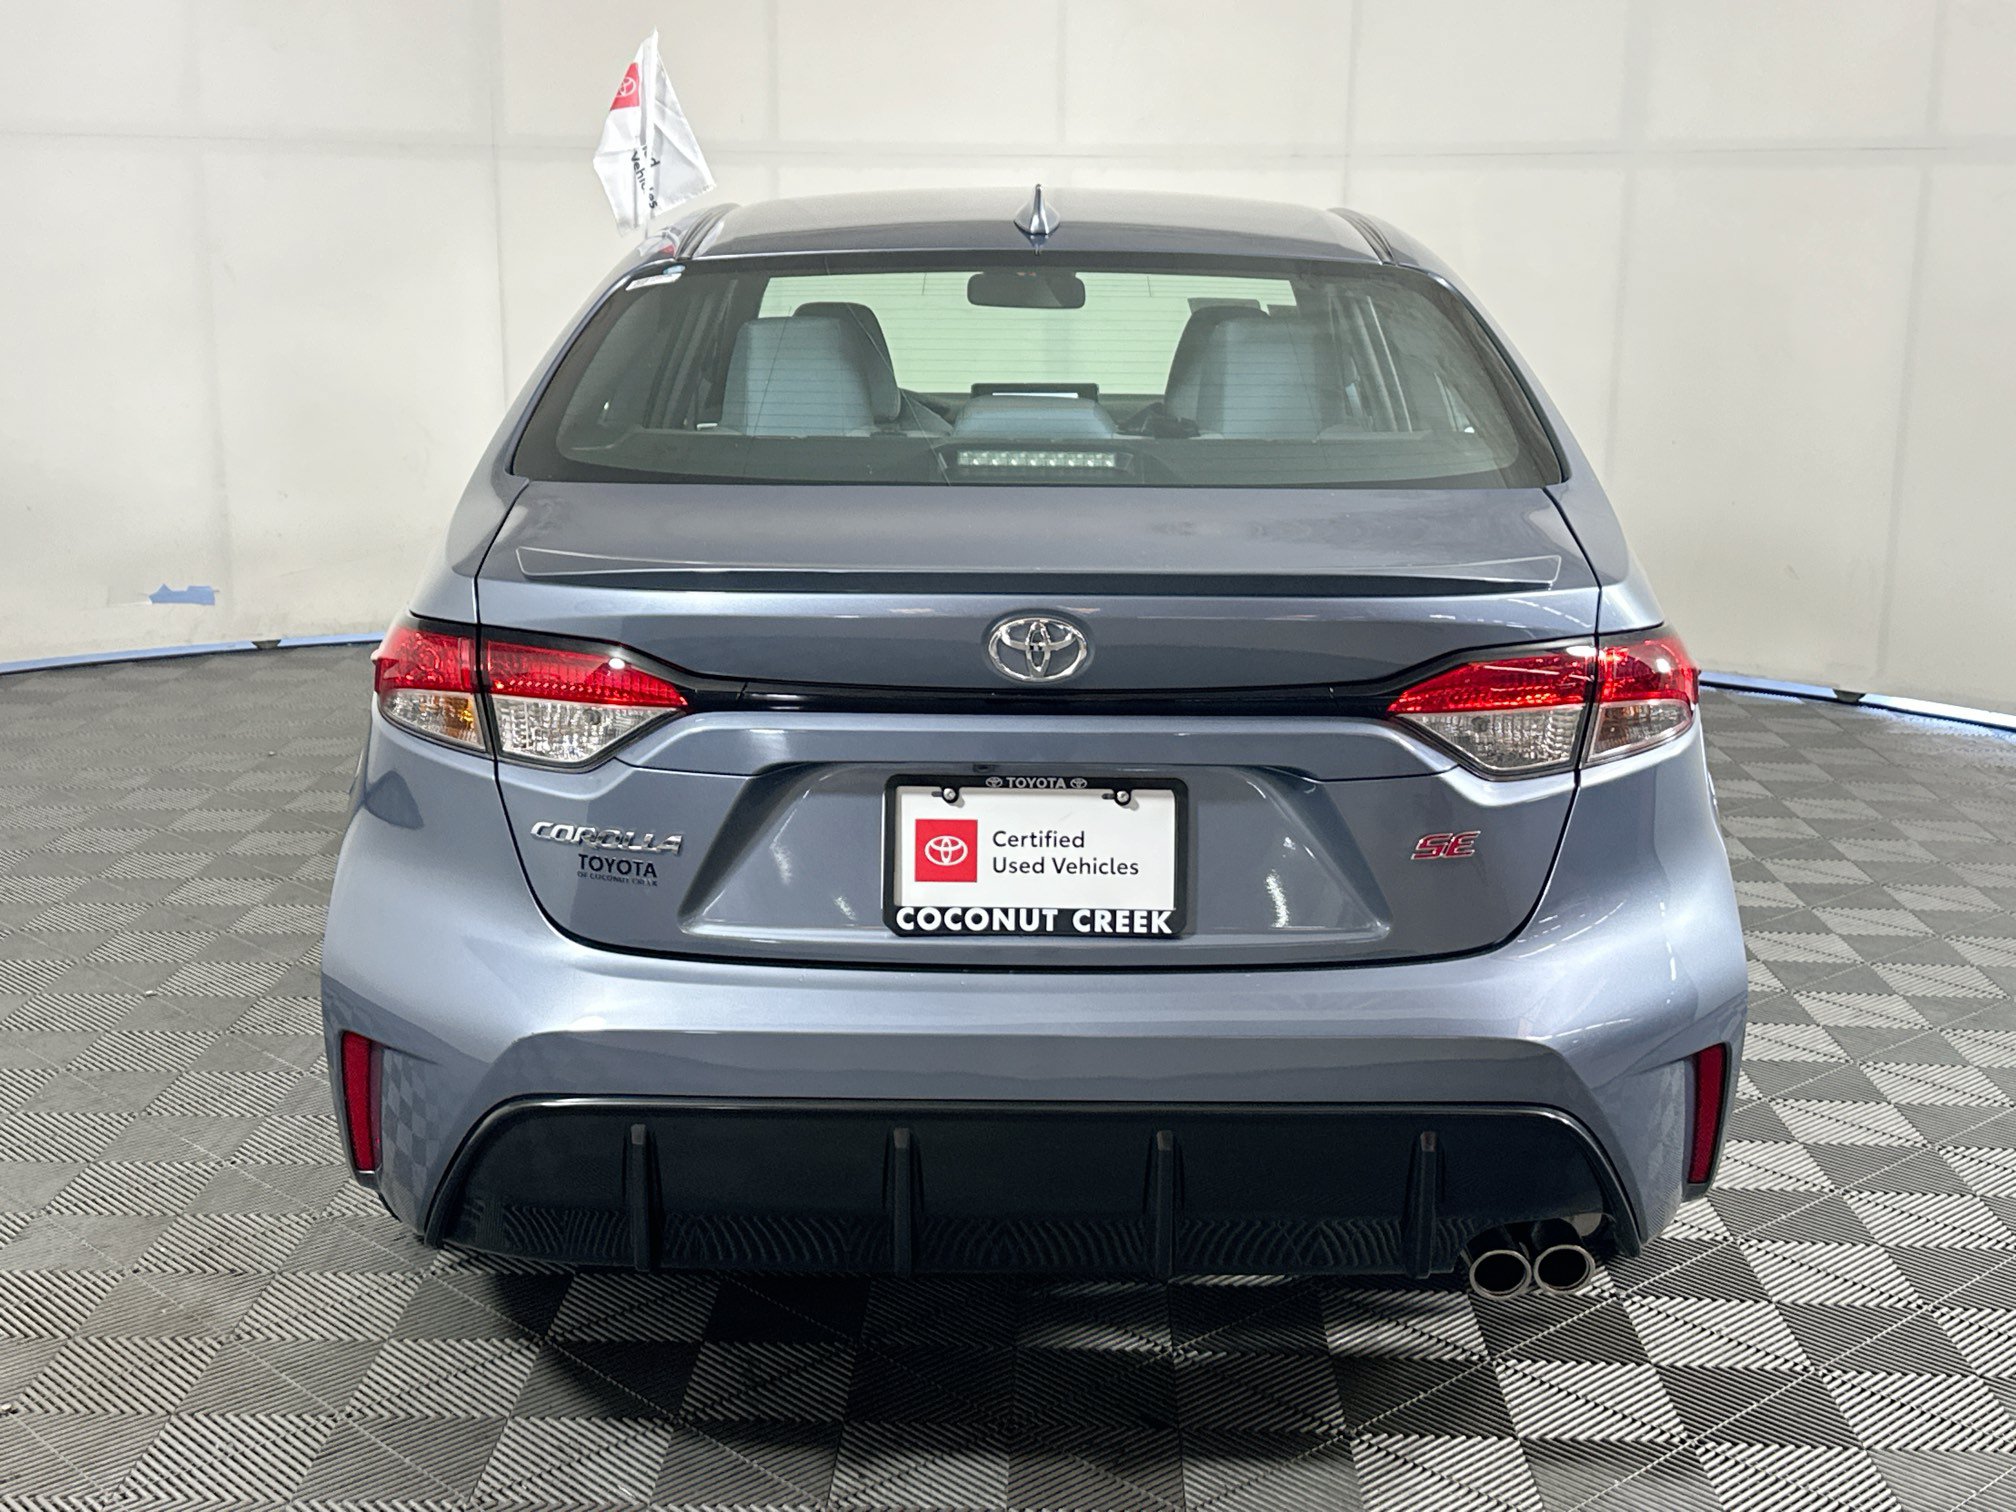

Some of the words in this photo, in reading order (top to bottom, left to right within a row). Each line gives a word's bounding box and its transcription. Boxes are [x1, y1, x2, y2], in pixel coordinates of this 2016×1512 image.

[1006, 777, 1067, 789] TOYOTA
[530, 821, 683, 855] COROLLA
[992, 830, 1085, 848] Certified
[1410, 831, 1481, 860] SE
[578, 853, 658, 878] TOYOTA
[992, 857, 1045, 875] Used
[1052, 857, 1139, 875] Vehicles
[896, 907, 1059, 932] COCONUT
[1072, 909, 1173, 934] CREEK
